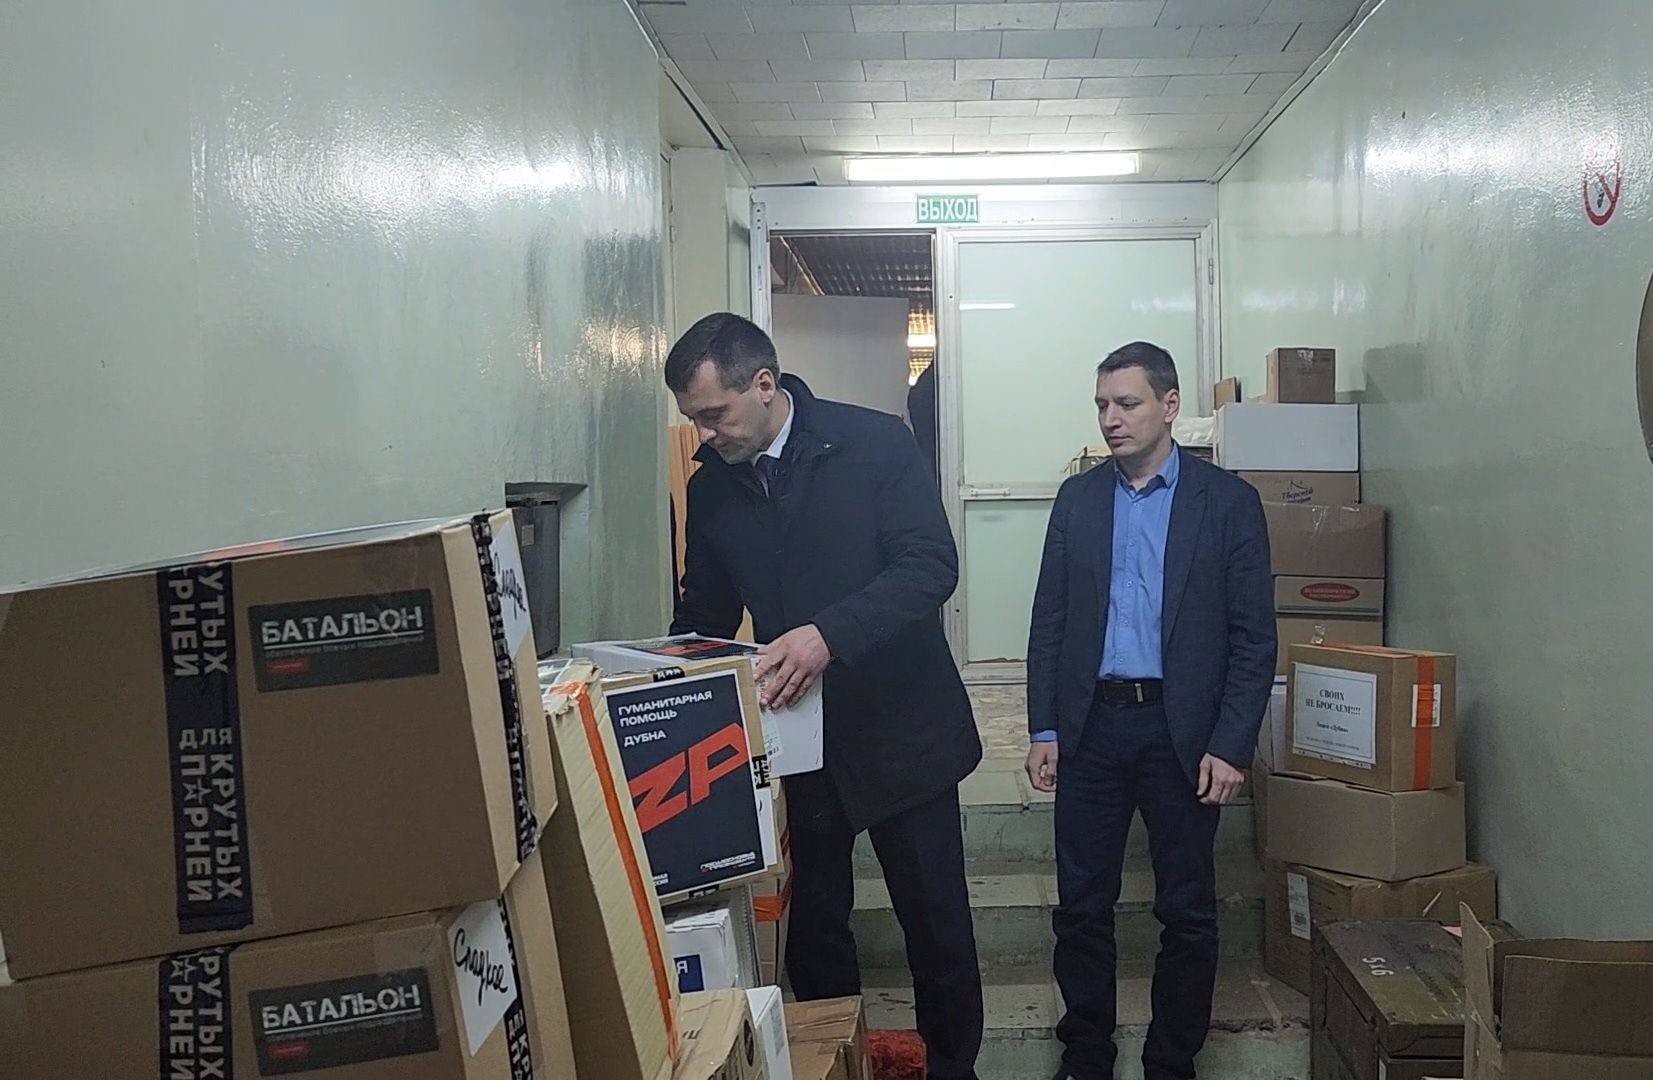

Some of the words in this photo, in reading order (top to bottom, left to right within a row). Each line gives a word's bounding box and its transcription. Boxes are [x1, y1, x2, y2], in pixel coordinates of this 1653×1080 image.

[918, 198, 978, 221] ВЫХОД
[198, 570, 229, 674] УТЫХ
[262, 606, 423, 644] БАТАЛЬОН
[618, 691, 713, 716] ГУМАНИТАРНАЯ
[1319, 689, 1345, 701] СВОИХ
[620, 709, 678, 728] ПОМОЩЬ
[624, 730, 667, 748] ДУБНА
[210, 753, 243, 899] КРУТЫХ
[676, 960, 688, 974] Я
[262, 984, 422, 1029] БАТАЛЬОН
